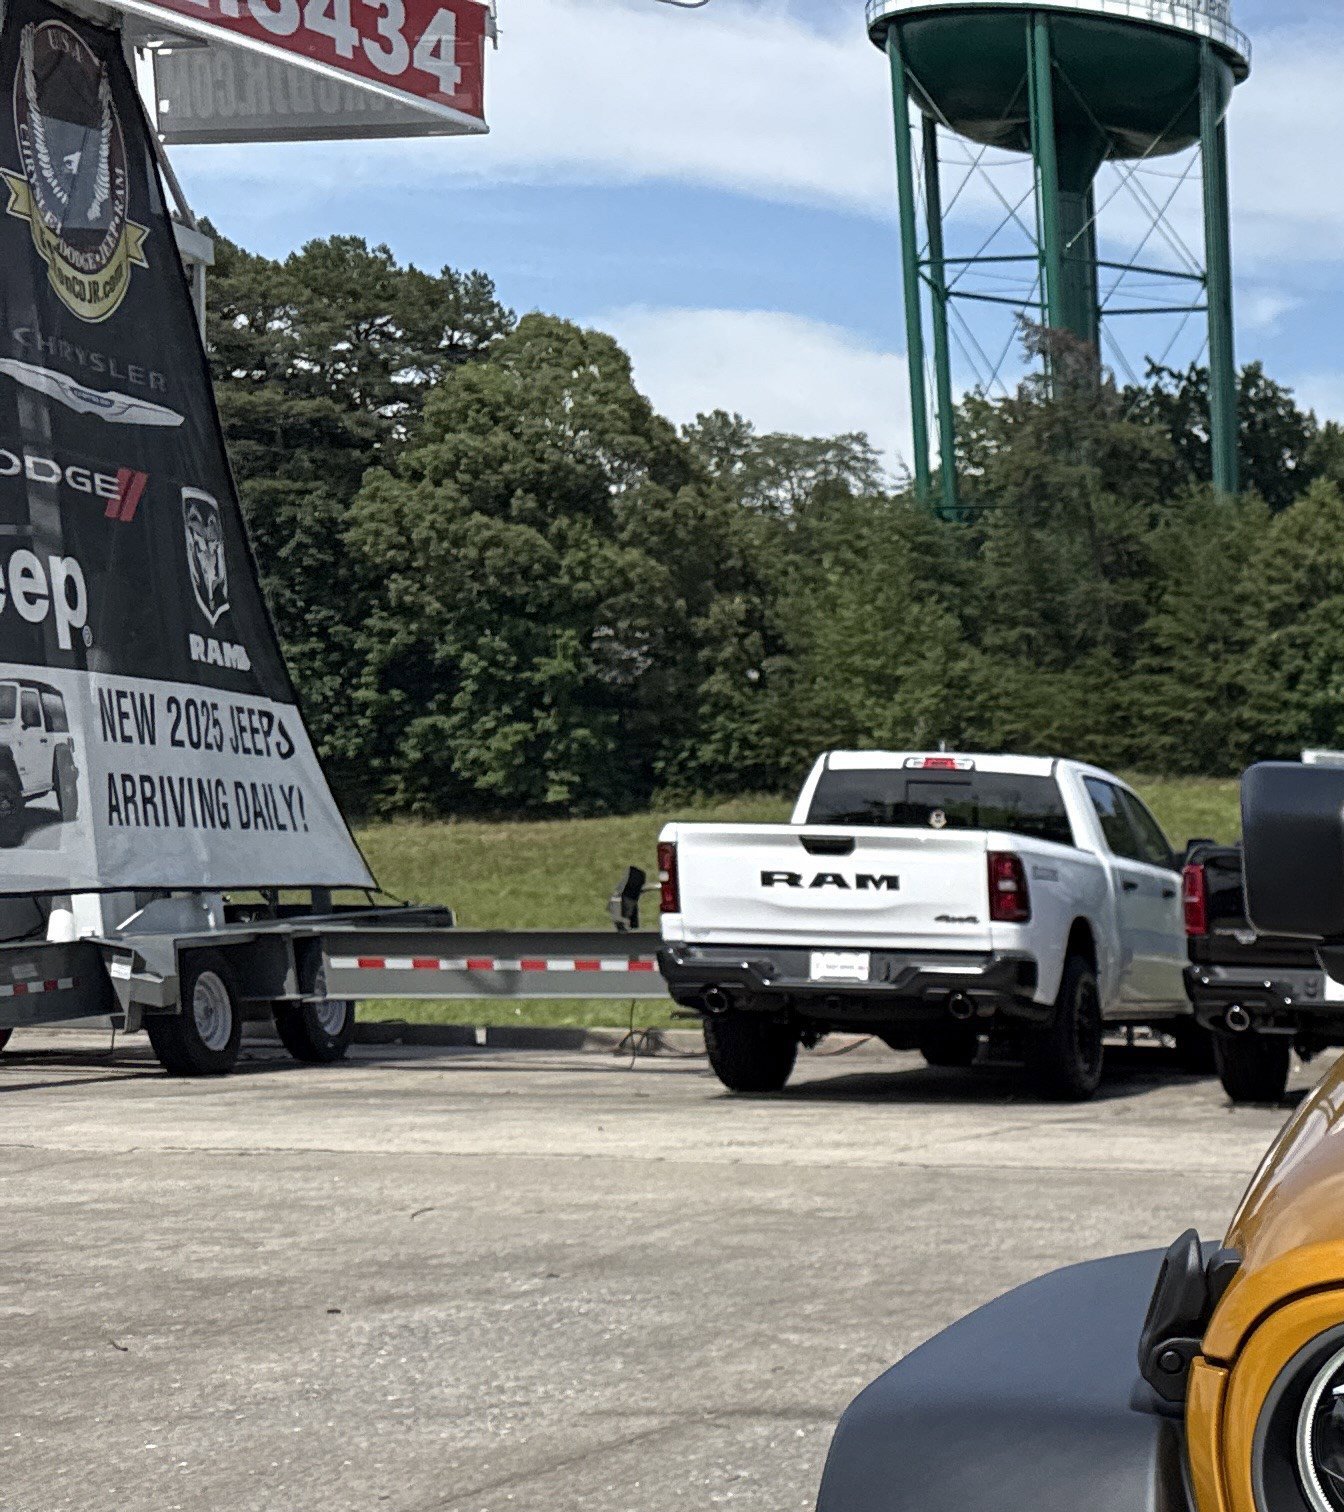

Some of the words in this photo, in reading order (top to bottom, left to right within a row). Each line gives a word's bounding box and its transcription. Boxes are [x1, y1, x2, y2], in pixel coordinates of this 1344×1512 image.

[13, 327, 167, 393] CHRYSLER
[189, 633, 251, 672] RAM
[98, 687, 157, 746] NEW
[167, 695, 224, 753] 2025
[229, 704, 296, 760] JEEPS
[108, 772, 232, 831] ARRIVING
[233, 780, 309, 833] DAILY!
[760, 871, 900, 891] RAM
